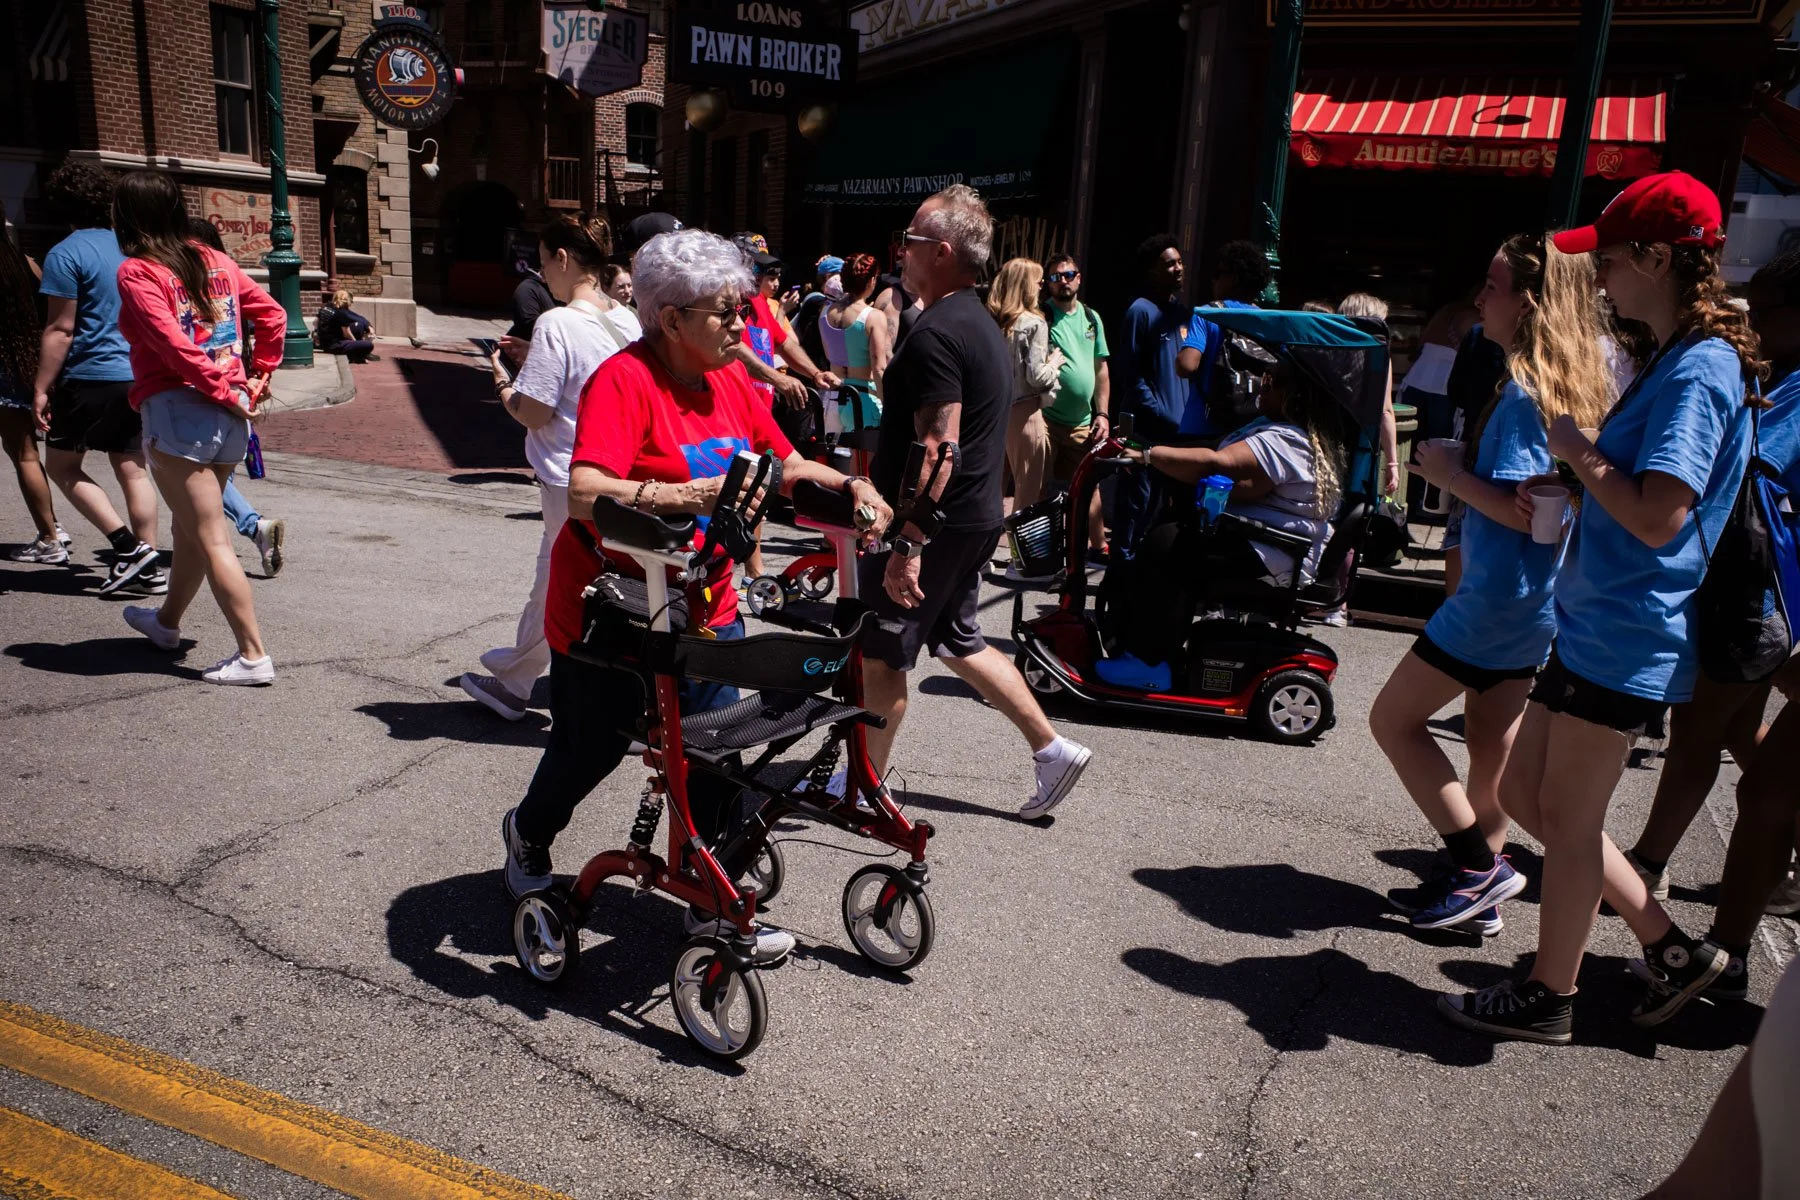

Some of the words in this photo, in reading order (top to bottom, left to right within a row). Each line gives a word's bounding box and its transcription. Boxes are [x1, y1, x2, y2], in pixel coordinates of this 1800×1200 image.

[737, 2, 802, 28] LOANS
[552, 8, 636, 62] SIEGLER
[689, 25, 753, 65] PAWN
[759, 36, 842, 81] BROKER
[750, 78, 786, 99] 109
[1354, 138, 1456, 167] Auntie
[1454, 144, 1558, 169] Anne's
[841, 177, 901, 196] NAZARMAN'S
[177, 278, 231, 305] ONDO
